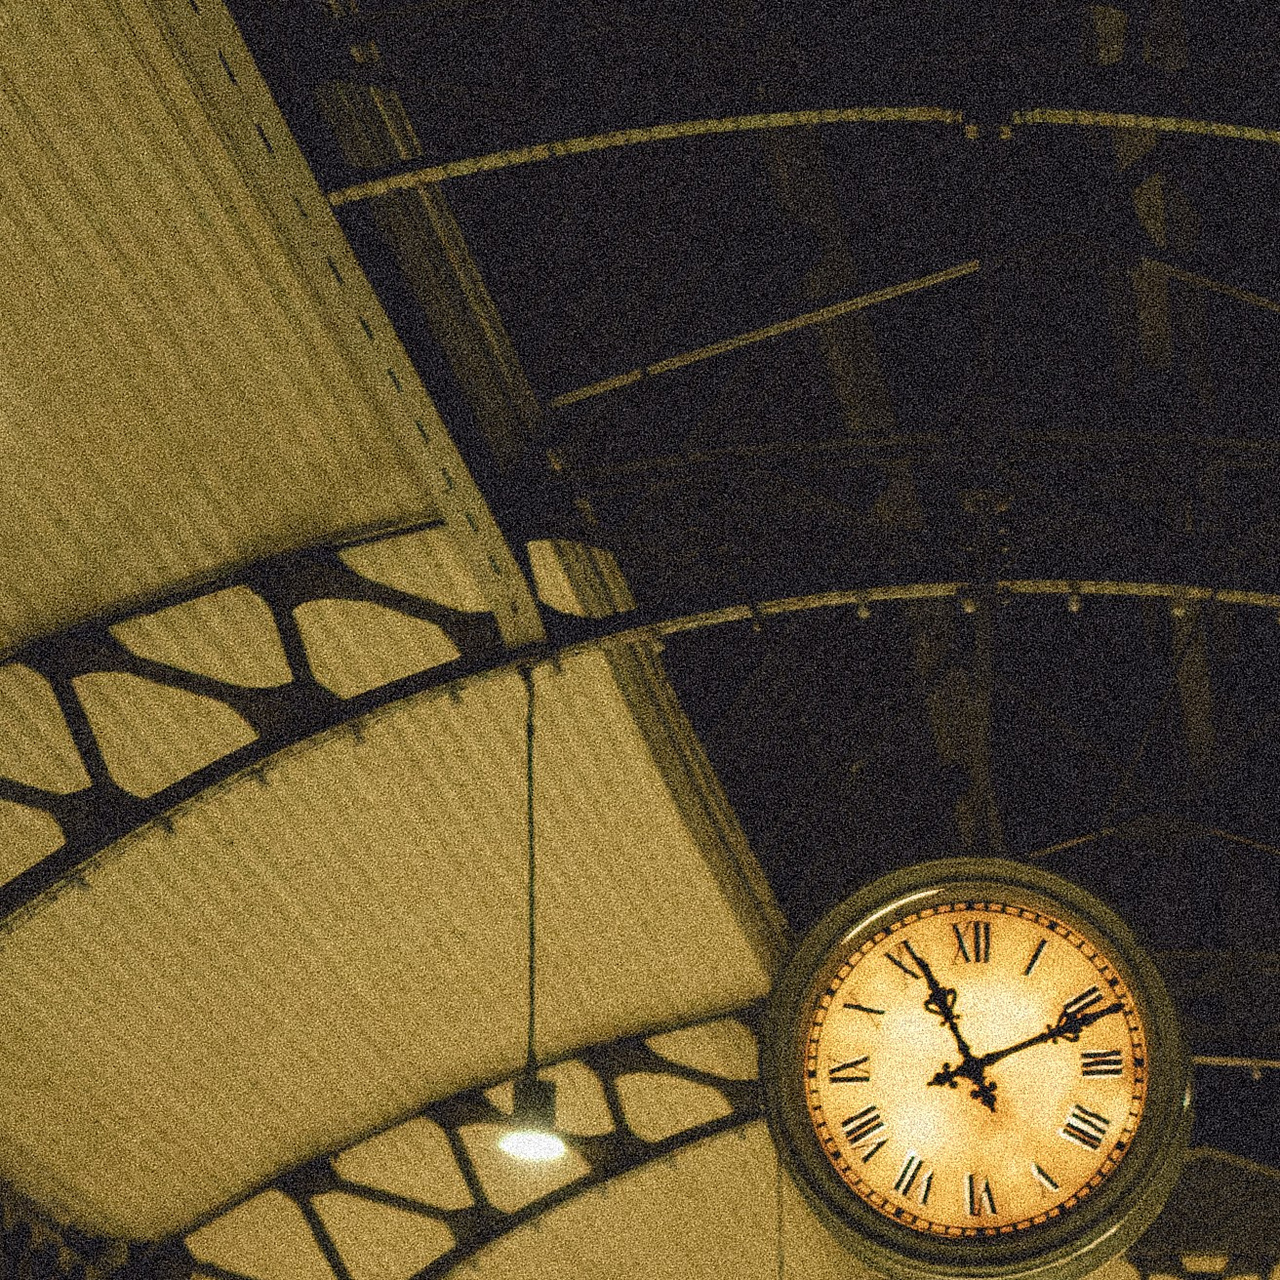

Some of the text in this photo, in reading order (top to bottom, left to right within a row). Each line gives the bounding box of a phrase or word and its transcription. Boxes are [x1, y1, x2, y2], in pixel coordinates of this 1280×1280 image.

[951, 921, 991, 965] XII
[1022, 938, 1048, 976] I
[1064, 986, 1104, 1013] II
[828, 1055, 870, 1084] IX
[1080, 1049, 1123, 1077] III
[841, 1104, 889, 1163] VIII
[1062, 1103, 1111, 1150] IIII
[894, 1155, 935, 1205] VII
[968, 1173, 998, 1216] VI
